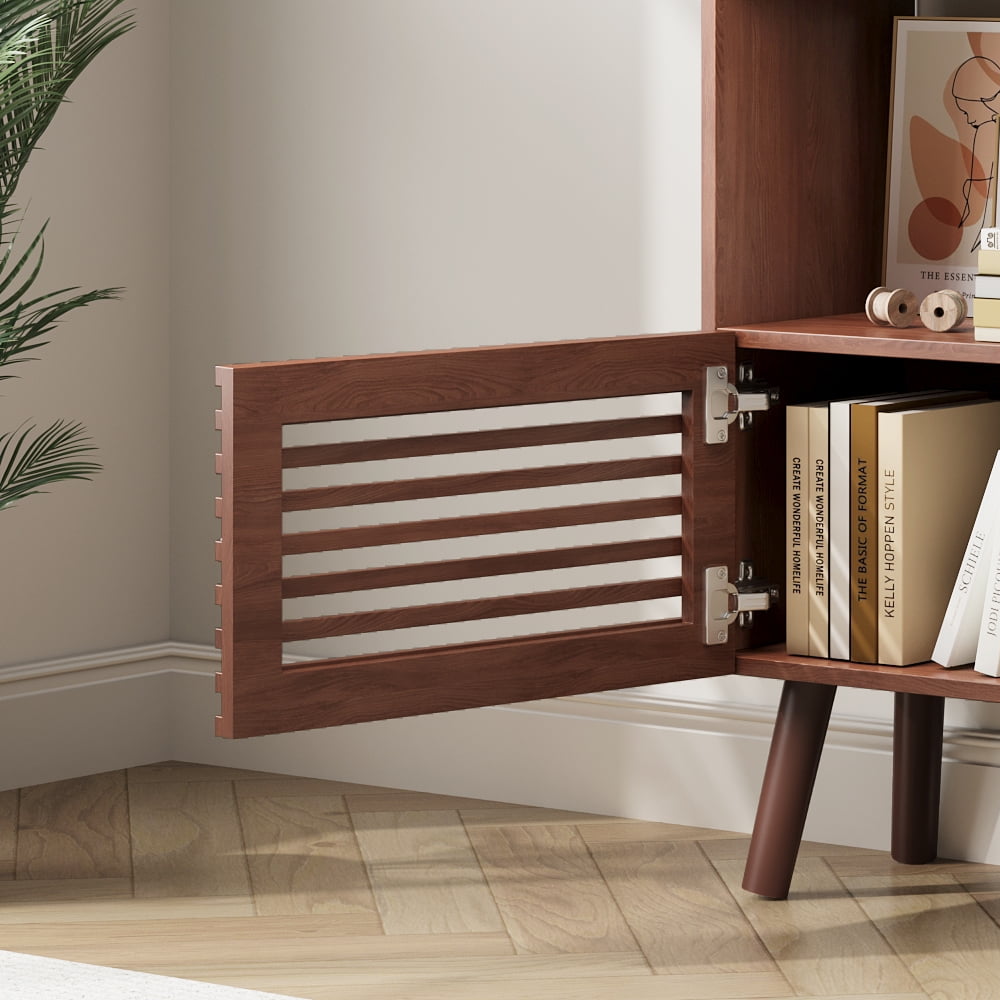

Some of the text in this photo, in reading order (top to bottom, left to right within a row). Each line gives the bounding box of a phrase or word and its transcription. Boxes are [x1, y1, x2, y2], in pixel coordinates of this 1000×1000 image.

[920, 271, 940, 281] THE
[792, 457, 801, 595] CREATE WONDERFUL HOMELIFE
[815, 458, 824, 597] CREATE WONDERFUL HOMELIFE
[857, 458, 868, 602] THE BASIC OF FORMAT
[884, 468, 895, 618] KELLY HOPPEN STYLE
[959, 531, 986, 594] SCHIELE
[986, 606, 999, 637] JODI
